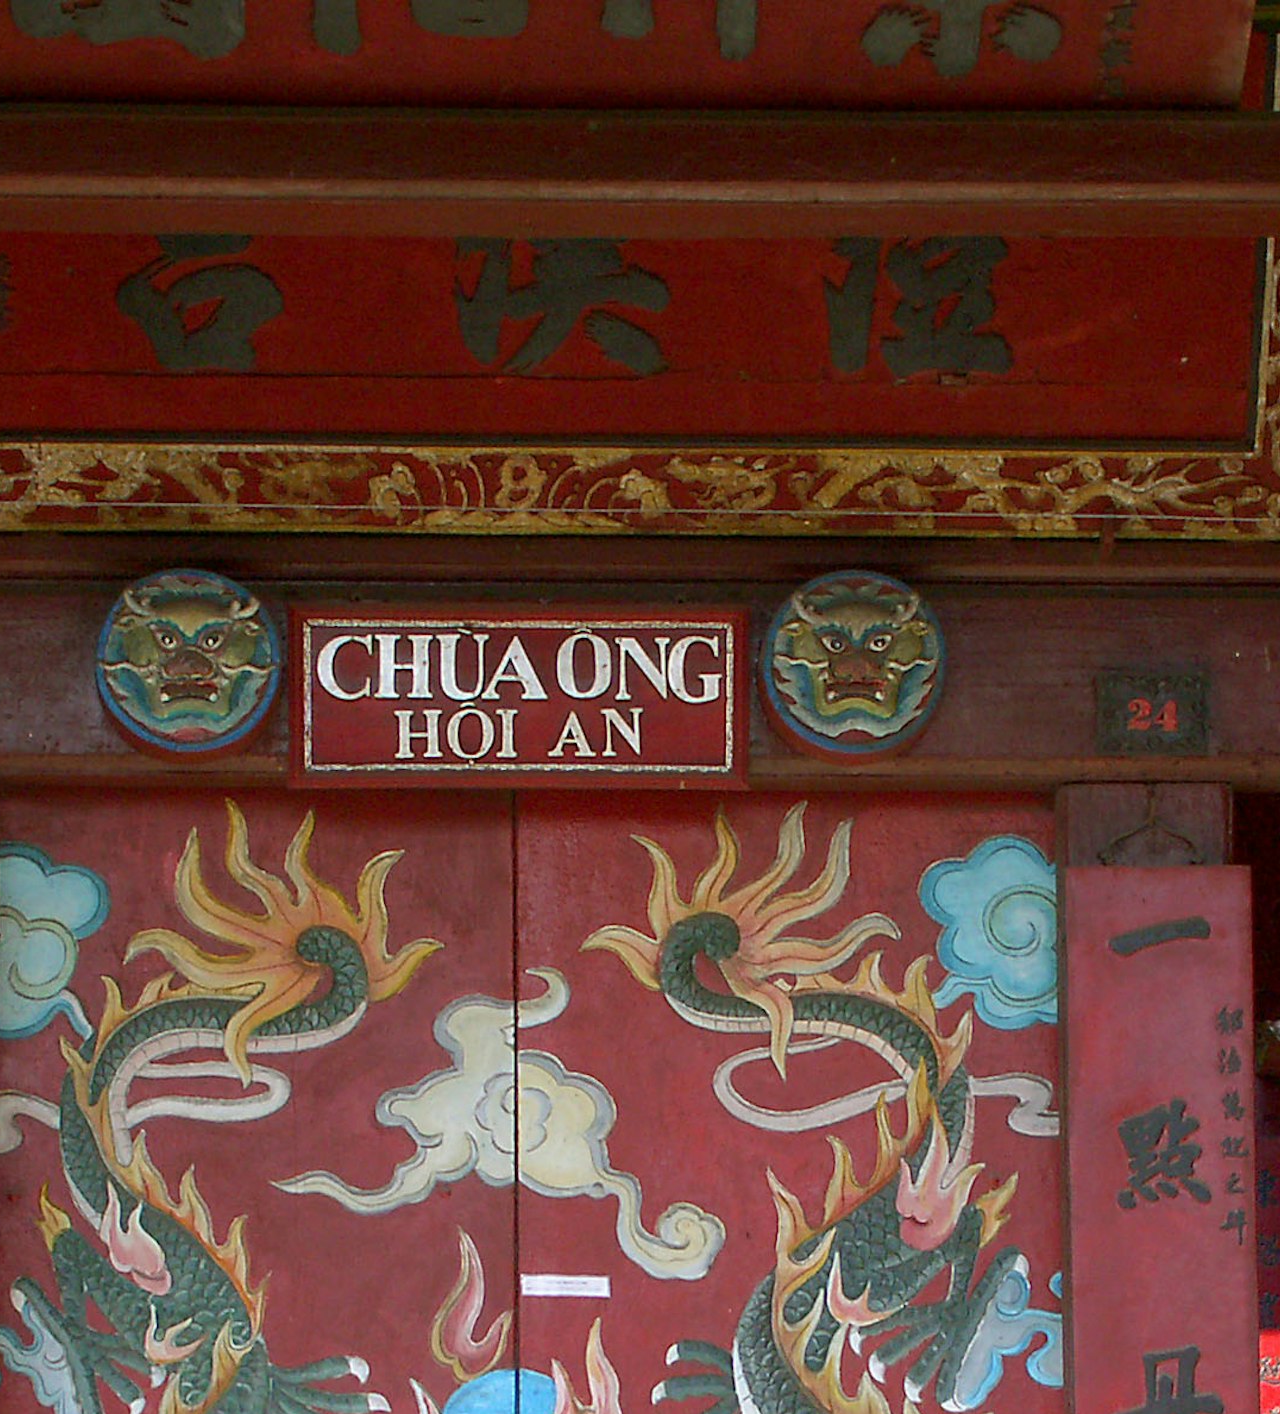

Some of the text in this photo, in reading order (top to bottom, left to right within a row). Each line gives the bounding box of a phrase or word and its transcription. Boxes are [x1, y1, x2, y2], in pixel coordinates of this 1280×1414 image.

[317, 628, 722, 704] CHÙA ÔNG
[394, 702, 643, 765] HỘI AN
[1127, 697, 1178, 731] 24
